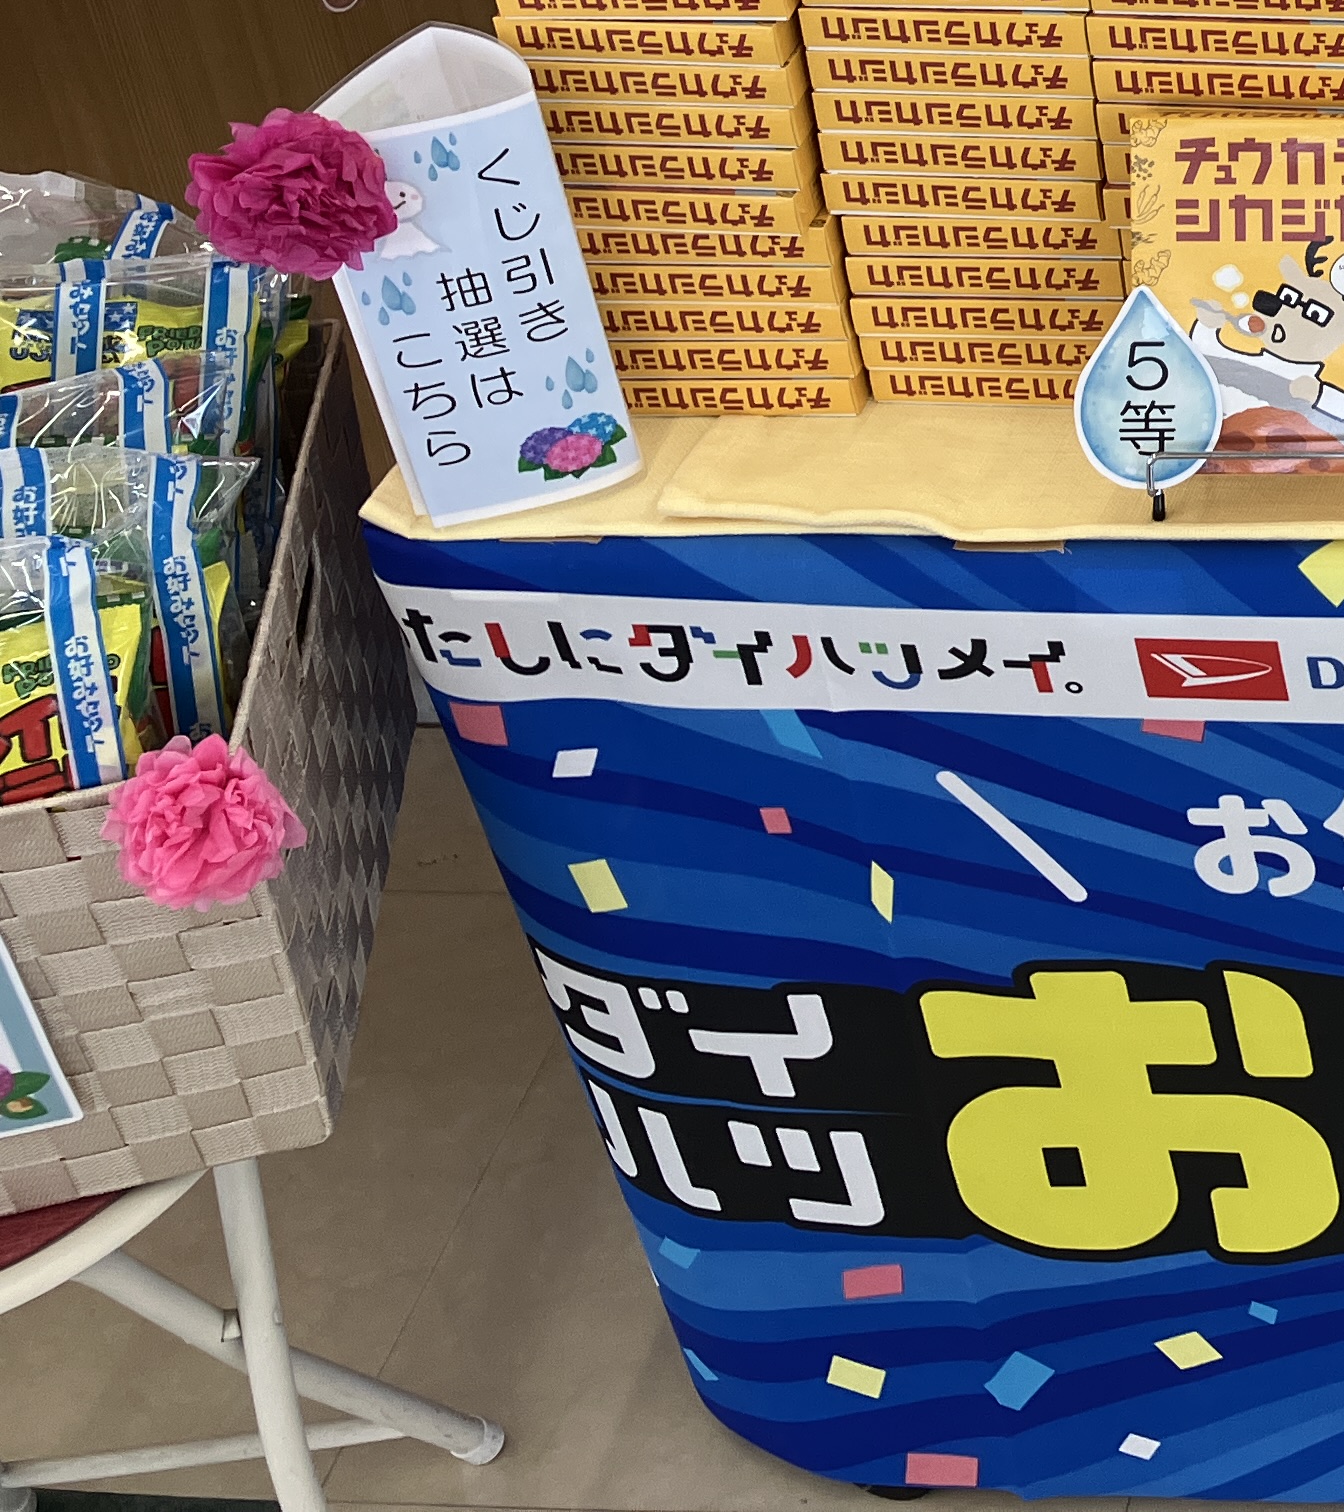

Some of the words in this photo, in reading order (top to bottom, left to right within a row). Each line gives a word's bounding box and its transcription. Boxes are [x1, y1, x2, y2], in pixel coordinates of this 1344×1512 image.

[516, 26, 753, 57] チュウカラシカジカ
[828, 59, 1068, 89] チュウカラシカジカ
[841, 141, 1076, 171] チュウカラシカジカ
[477, 147, 569, 343] くじ引き
[864, 225, 1097, 250] チュウカラシカジカ
[436, 267, 524, 408] 抽選は
[872, 307, 1103, 331] チュウカラシカジカ
[393, 332, 472, 467] こちら
[1118, 341, 1177, 456] 5等
[163, 554, 201, 666] お好みセット
[64, 634, 105, 753] お好みセット
[534, 945, 834, 1100] ダイ
